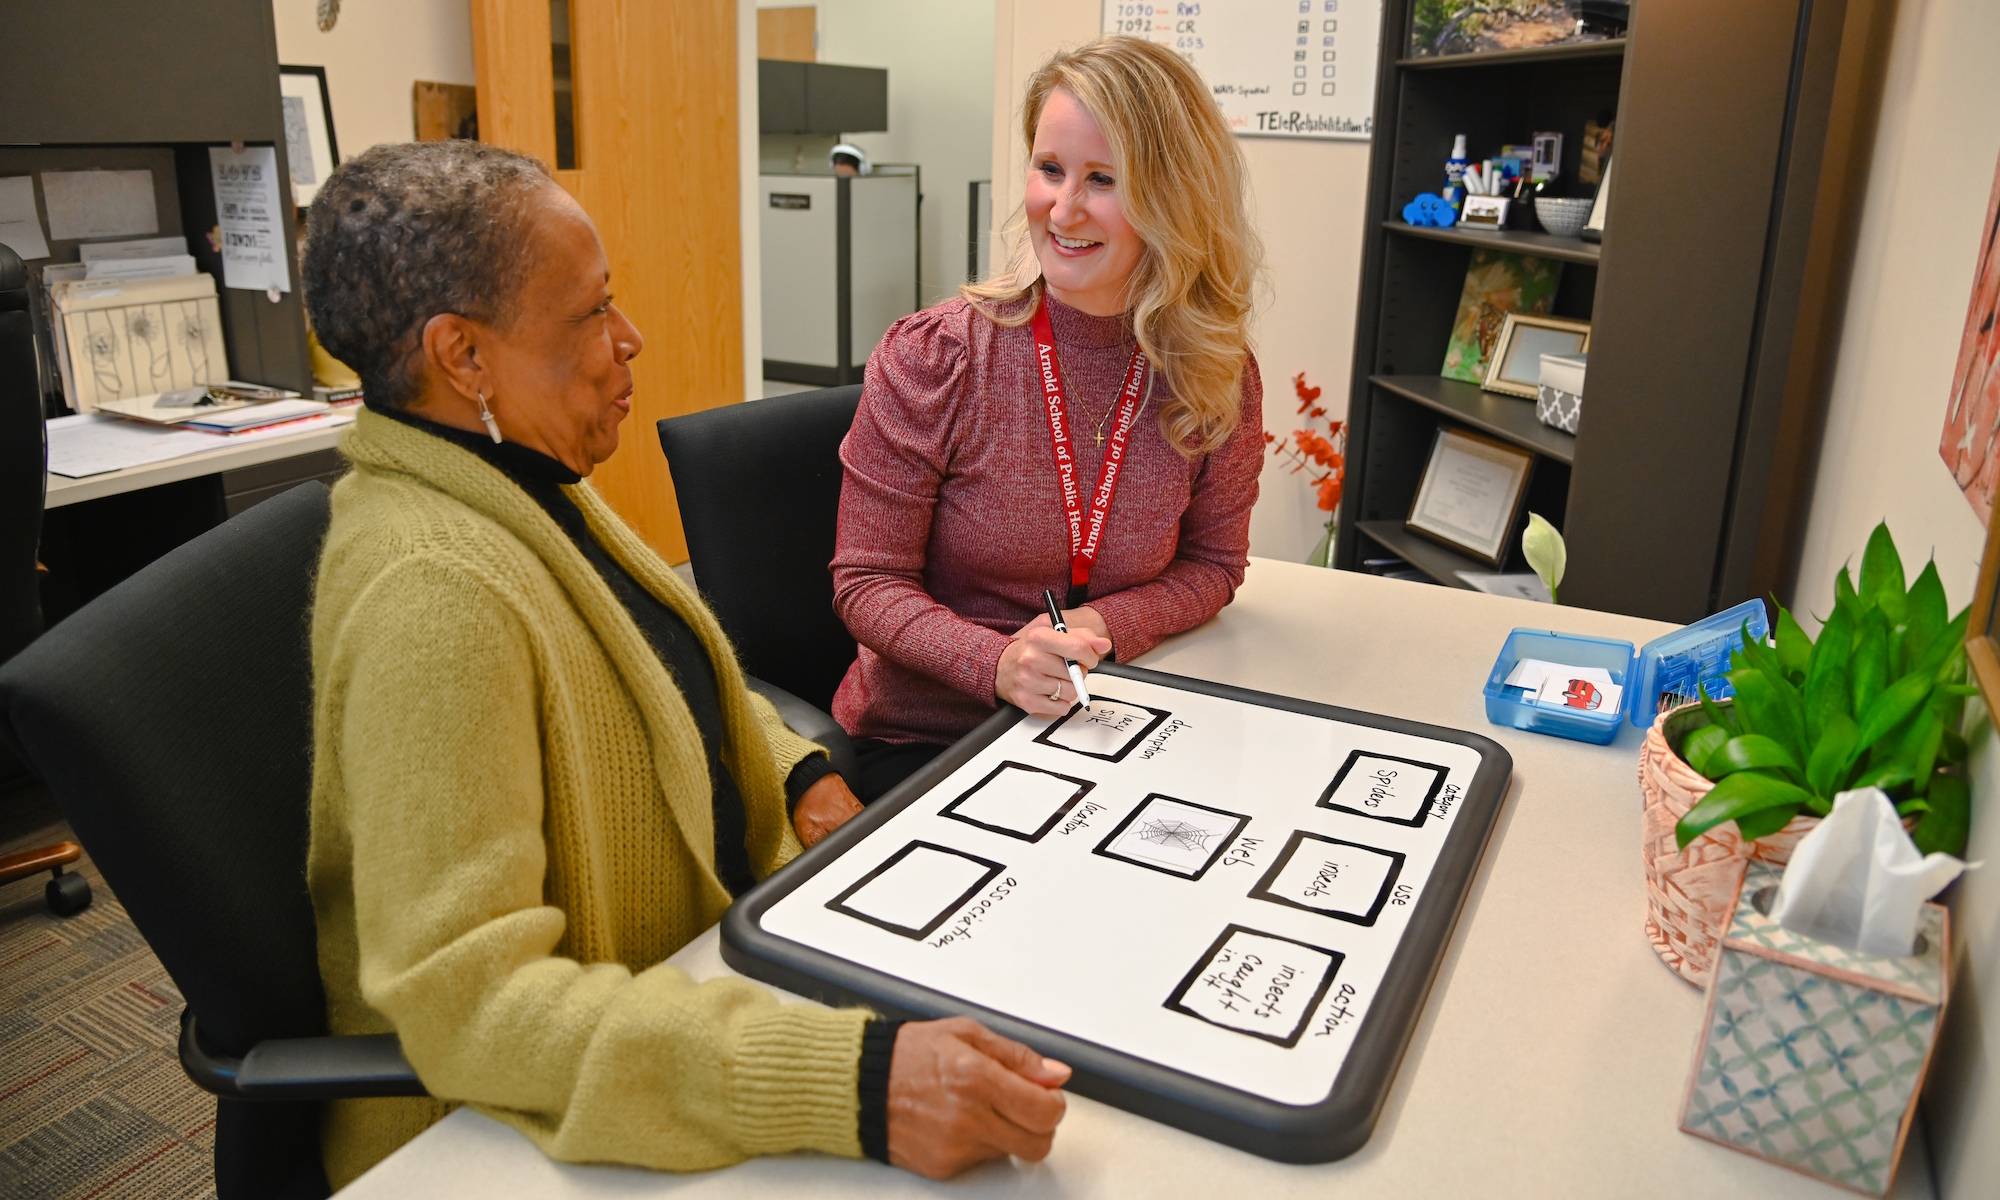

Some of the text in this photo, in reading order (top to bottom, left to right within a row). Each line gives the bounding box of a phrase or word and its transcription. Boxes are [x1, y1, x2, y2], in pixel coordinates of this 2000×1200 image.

[1117, 4, 1153, 17] 7090
[1117, 18, 1196, 34] 7092 CR
[1038, 342, 1059, 393] Arnold
[1047, 395, 1067, 443] School
[1056, 445, 1073, 462] of
[1081, 351, 1147, 559] Arnold School of Public Health
[1059, 462, 1077, 509] Public
[1101, 713, 1146, 732] lacy
[1138, 719, 1193, 760] description
[1057, 801, 1108, 836] location
[1304, 860, 1349, 898] insects
[928, 877, 1017, 949] association
[1217, 949, 1238, 964] in
[1217, 953, 1263, 1013] caught
[1254, 964, 1305, 1019] insects
[1314, 983, 1356, 1038] action
